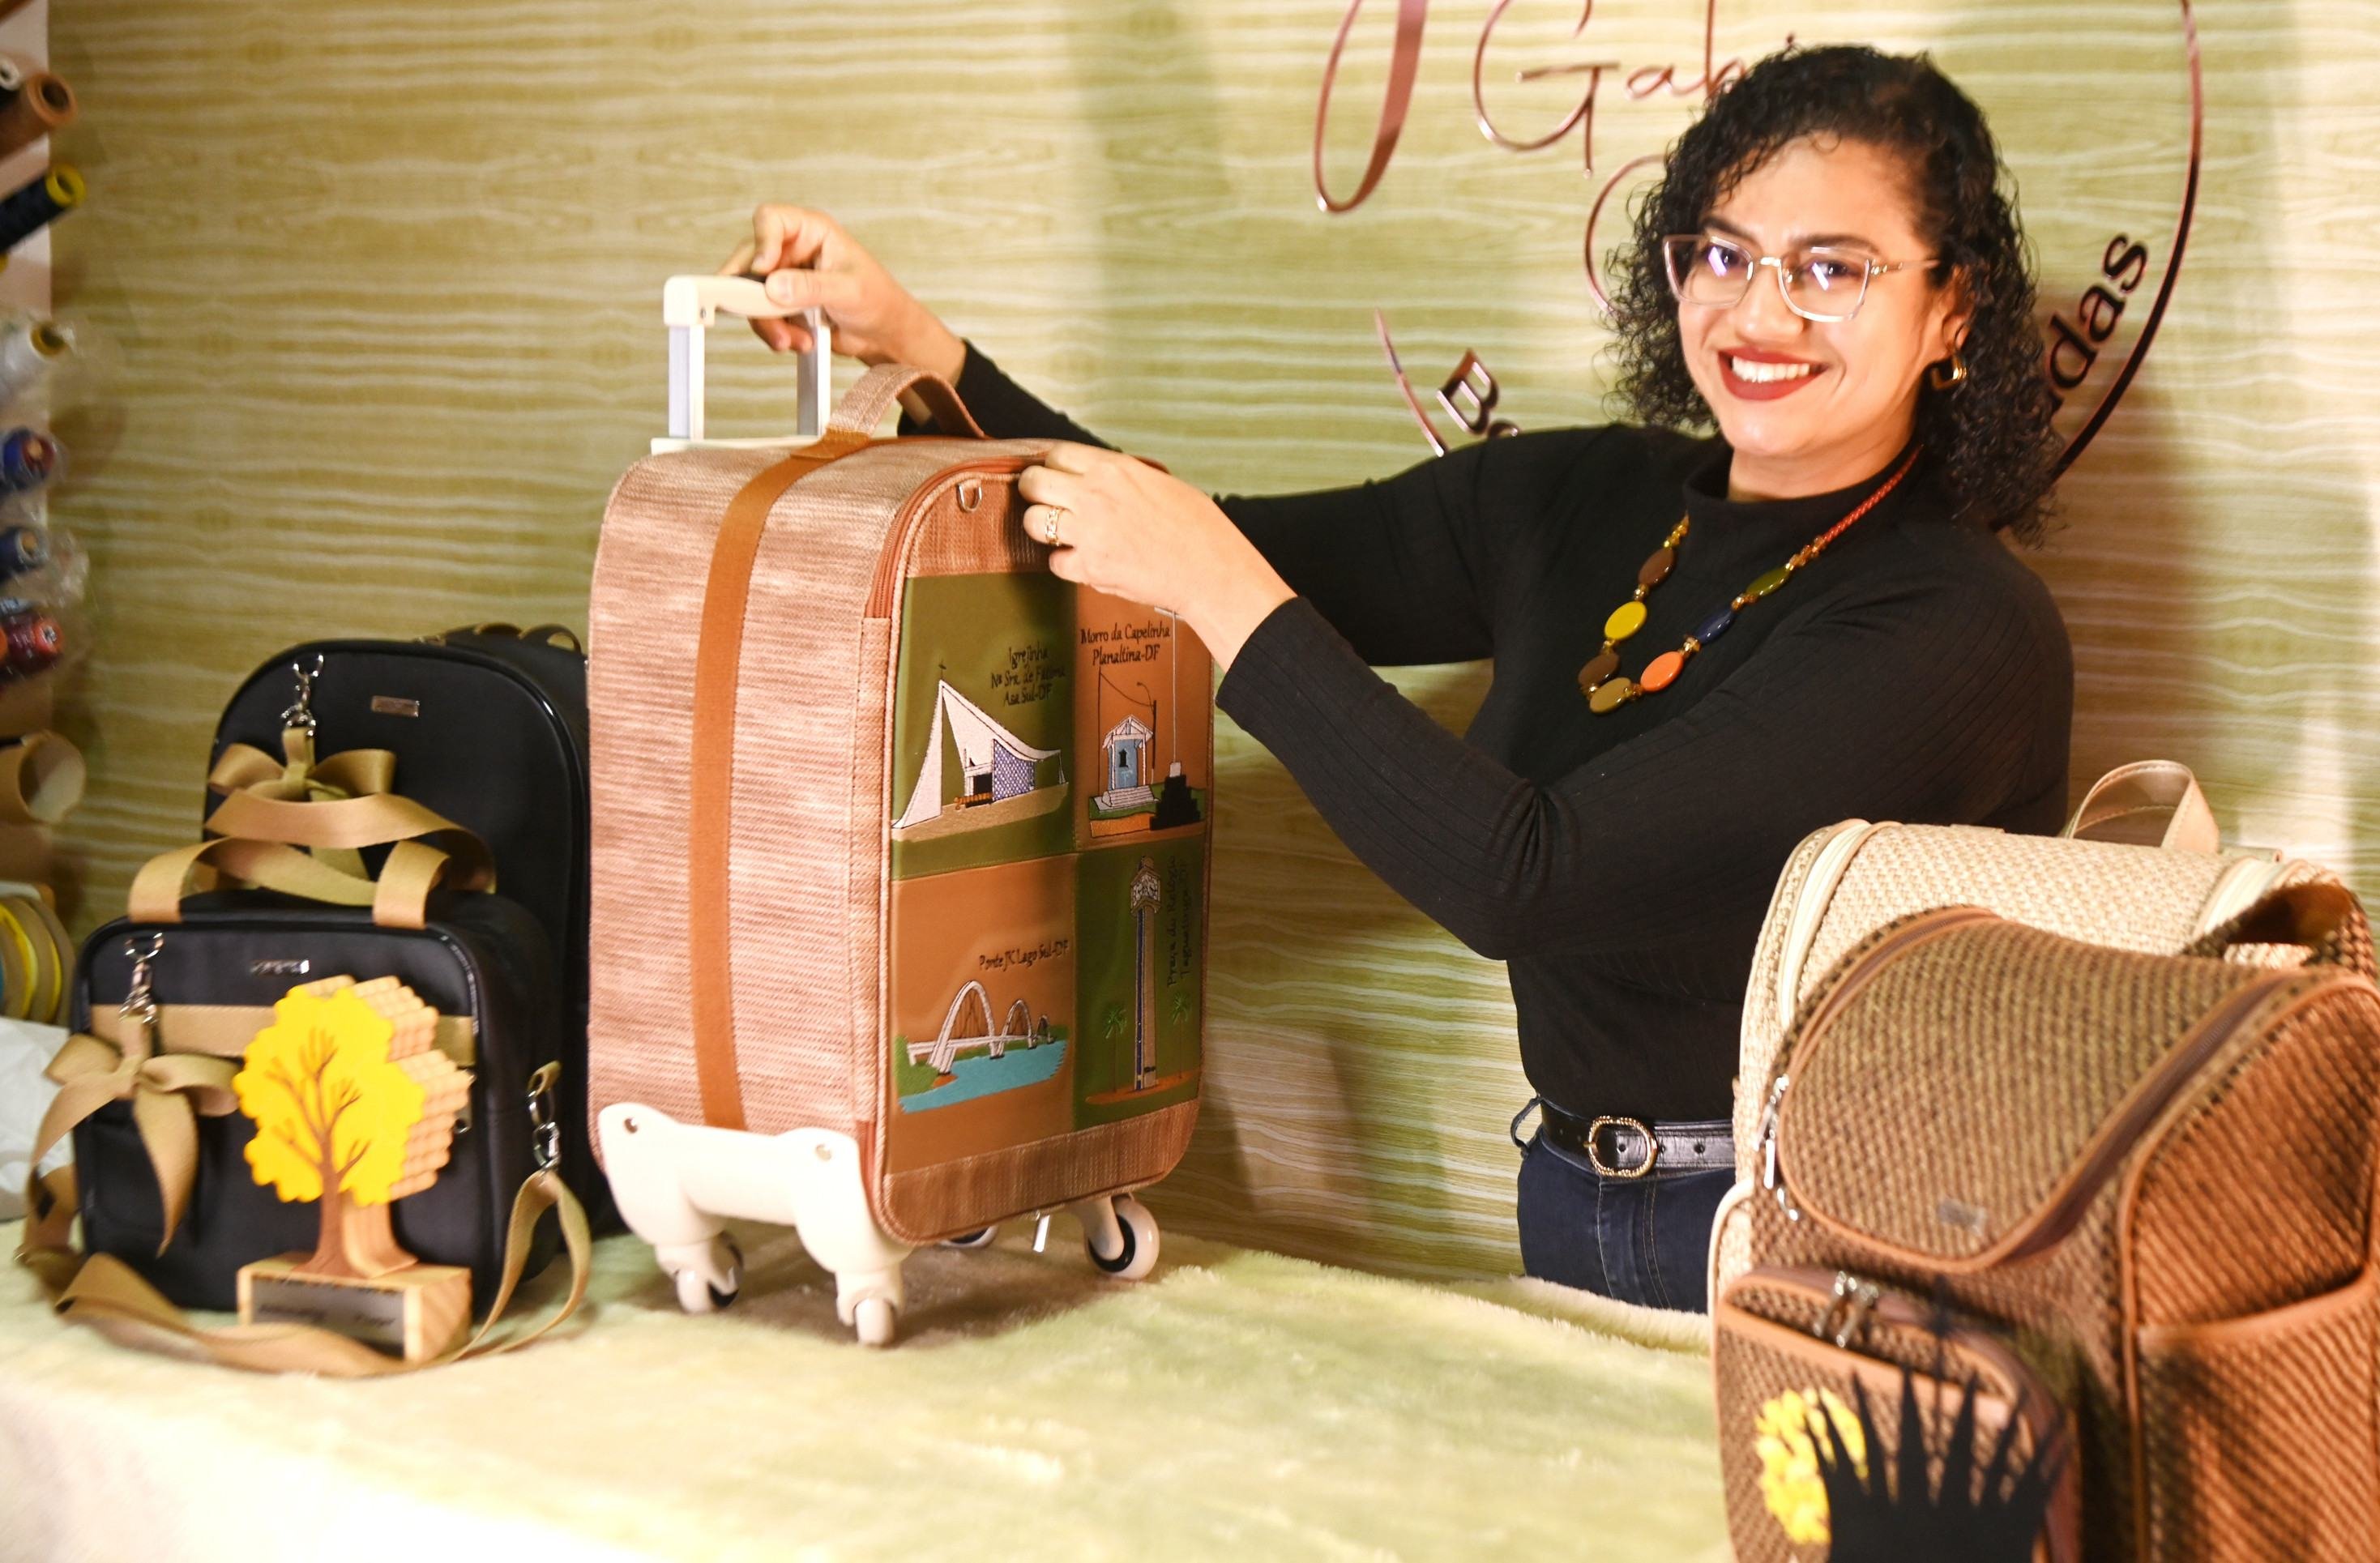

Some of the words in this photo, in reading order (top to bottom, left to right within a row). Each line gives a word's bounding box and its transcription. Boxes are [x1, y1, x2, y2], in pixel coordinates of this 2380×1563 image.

[1080, 628, 1109, 644] Morro
[1111, 621, 1122, 641] da
[1125, 619, 1170, 644] Capelinha
[1092, 643, 1160, 666] Planaltina-DF
[979, 954, 1003, 972] Ponte
